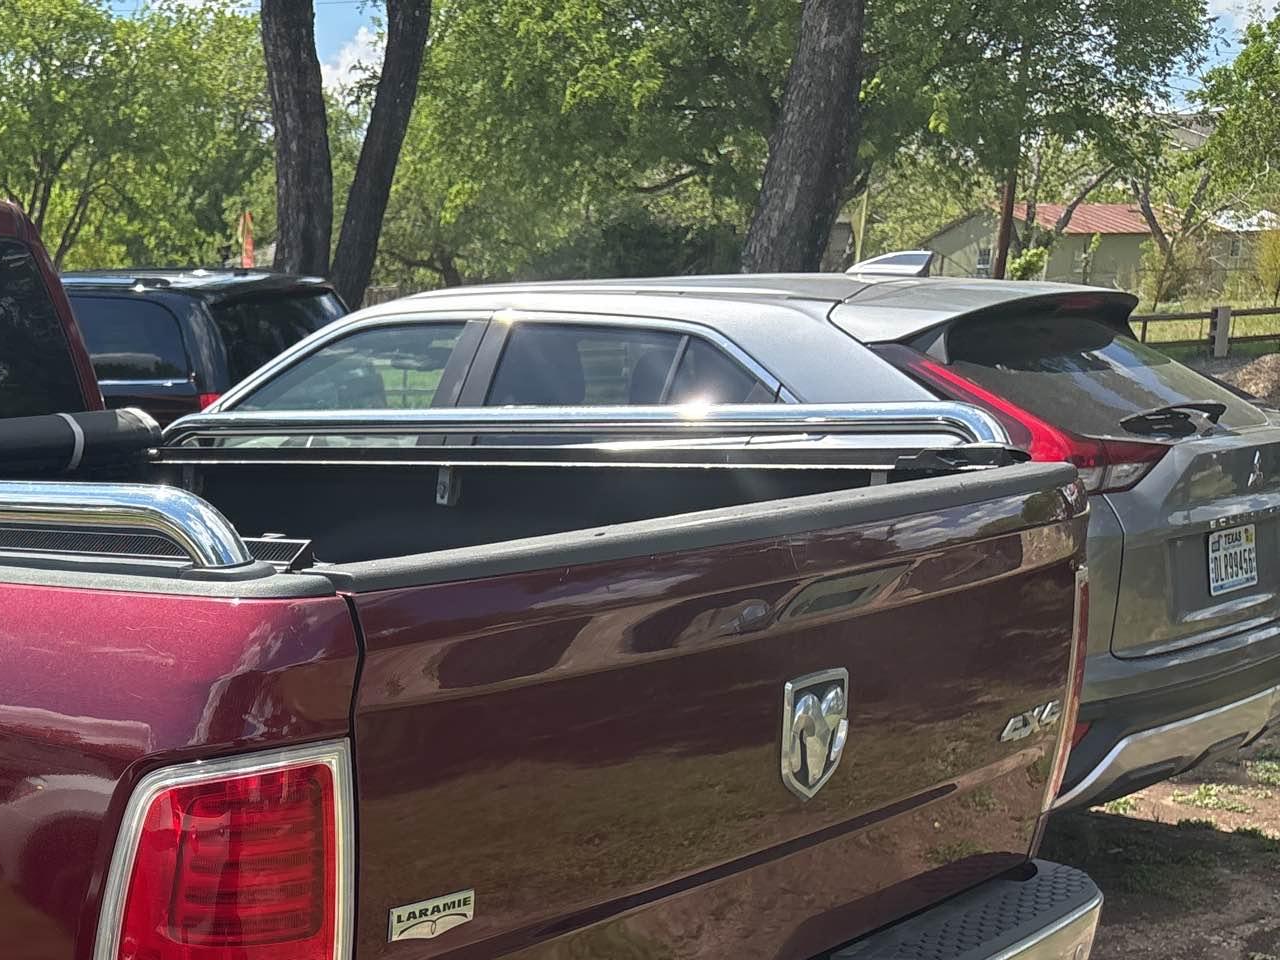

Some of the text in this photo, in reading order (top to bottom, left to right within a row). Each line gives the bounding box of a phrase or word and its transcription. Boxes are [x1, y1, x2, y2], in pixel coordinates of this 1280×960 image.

[1224, 530, 1242, 546] TEXAS
[1213, 547, 1254, 584] DLR99456
[396, 896, 471, 924] LARAMIE
